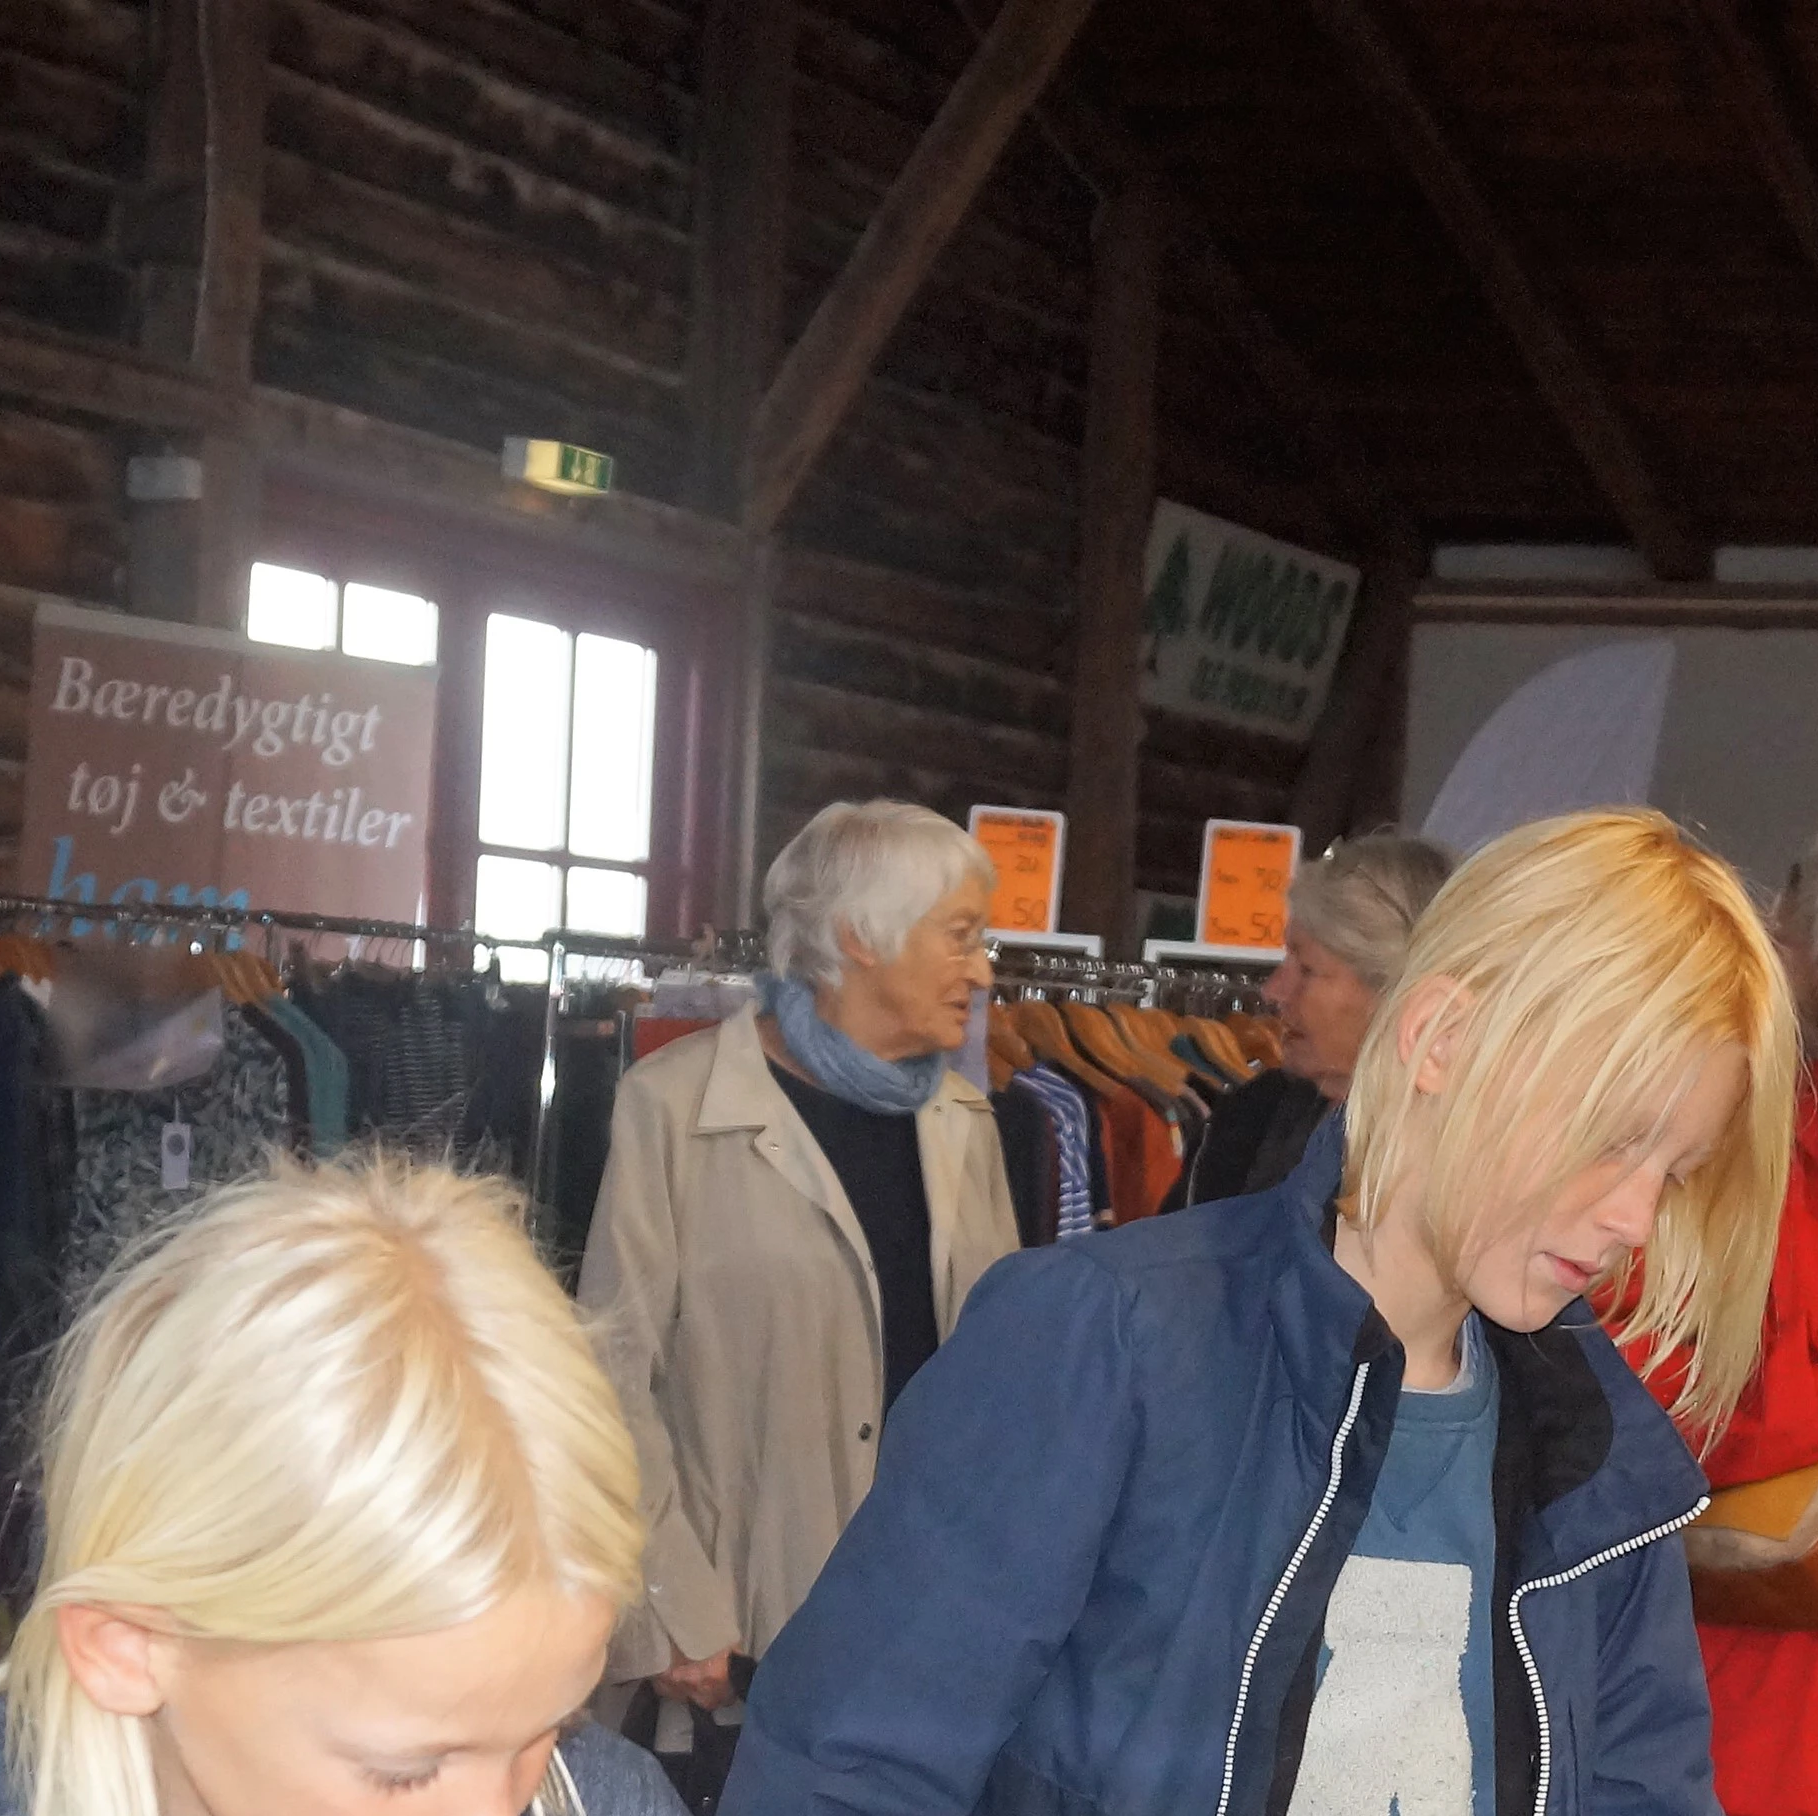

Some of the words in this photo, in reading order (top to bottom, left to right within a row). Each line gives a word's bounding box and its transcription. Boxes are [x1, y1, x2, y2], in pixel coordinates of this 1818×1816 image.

[51, 657, 381, 766] Bæredygtigt
[67, 763, 144, 834] tøj
[157, 767, 206, 823] &
[221, 781, 413, 849] textiler
